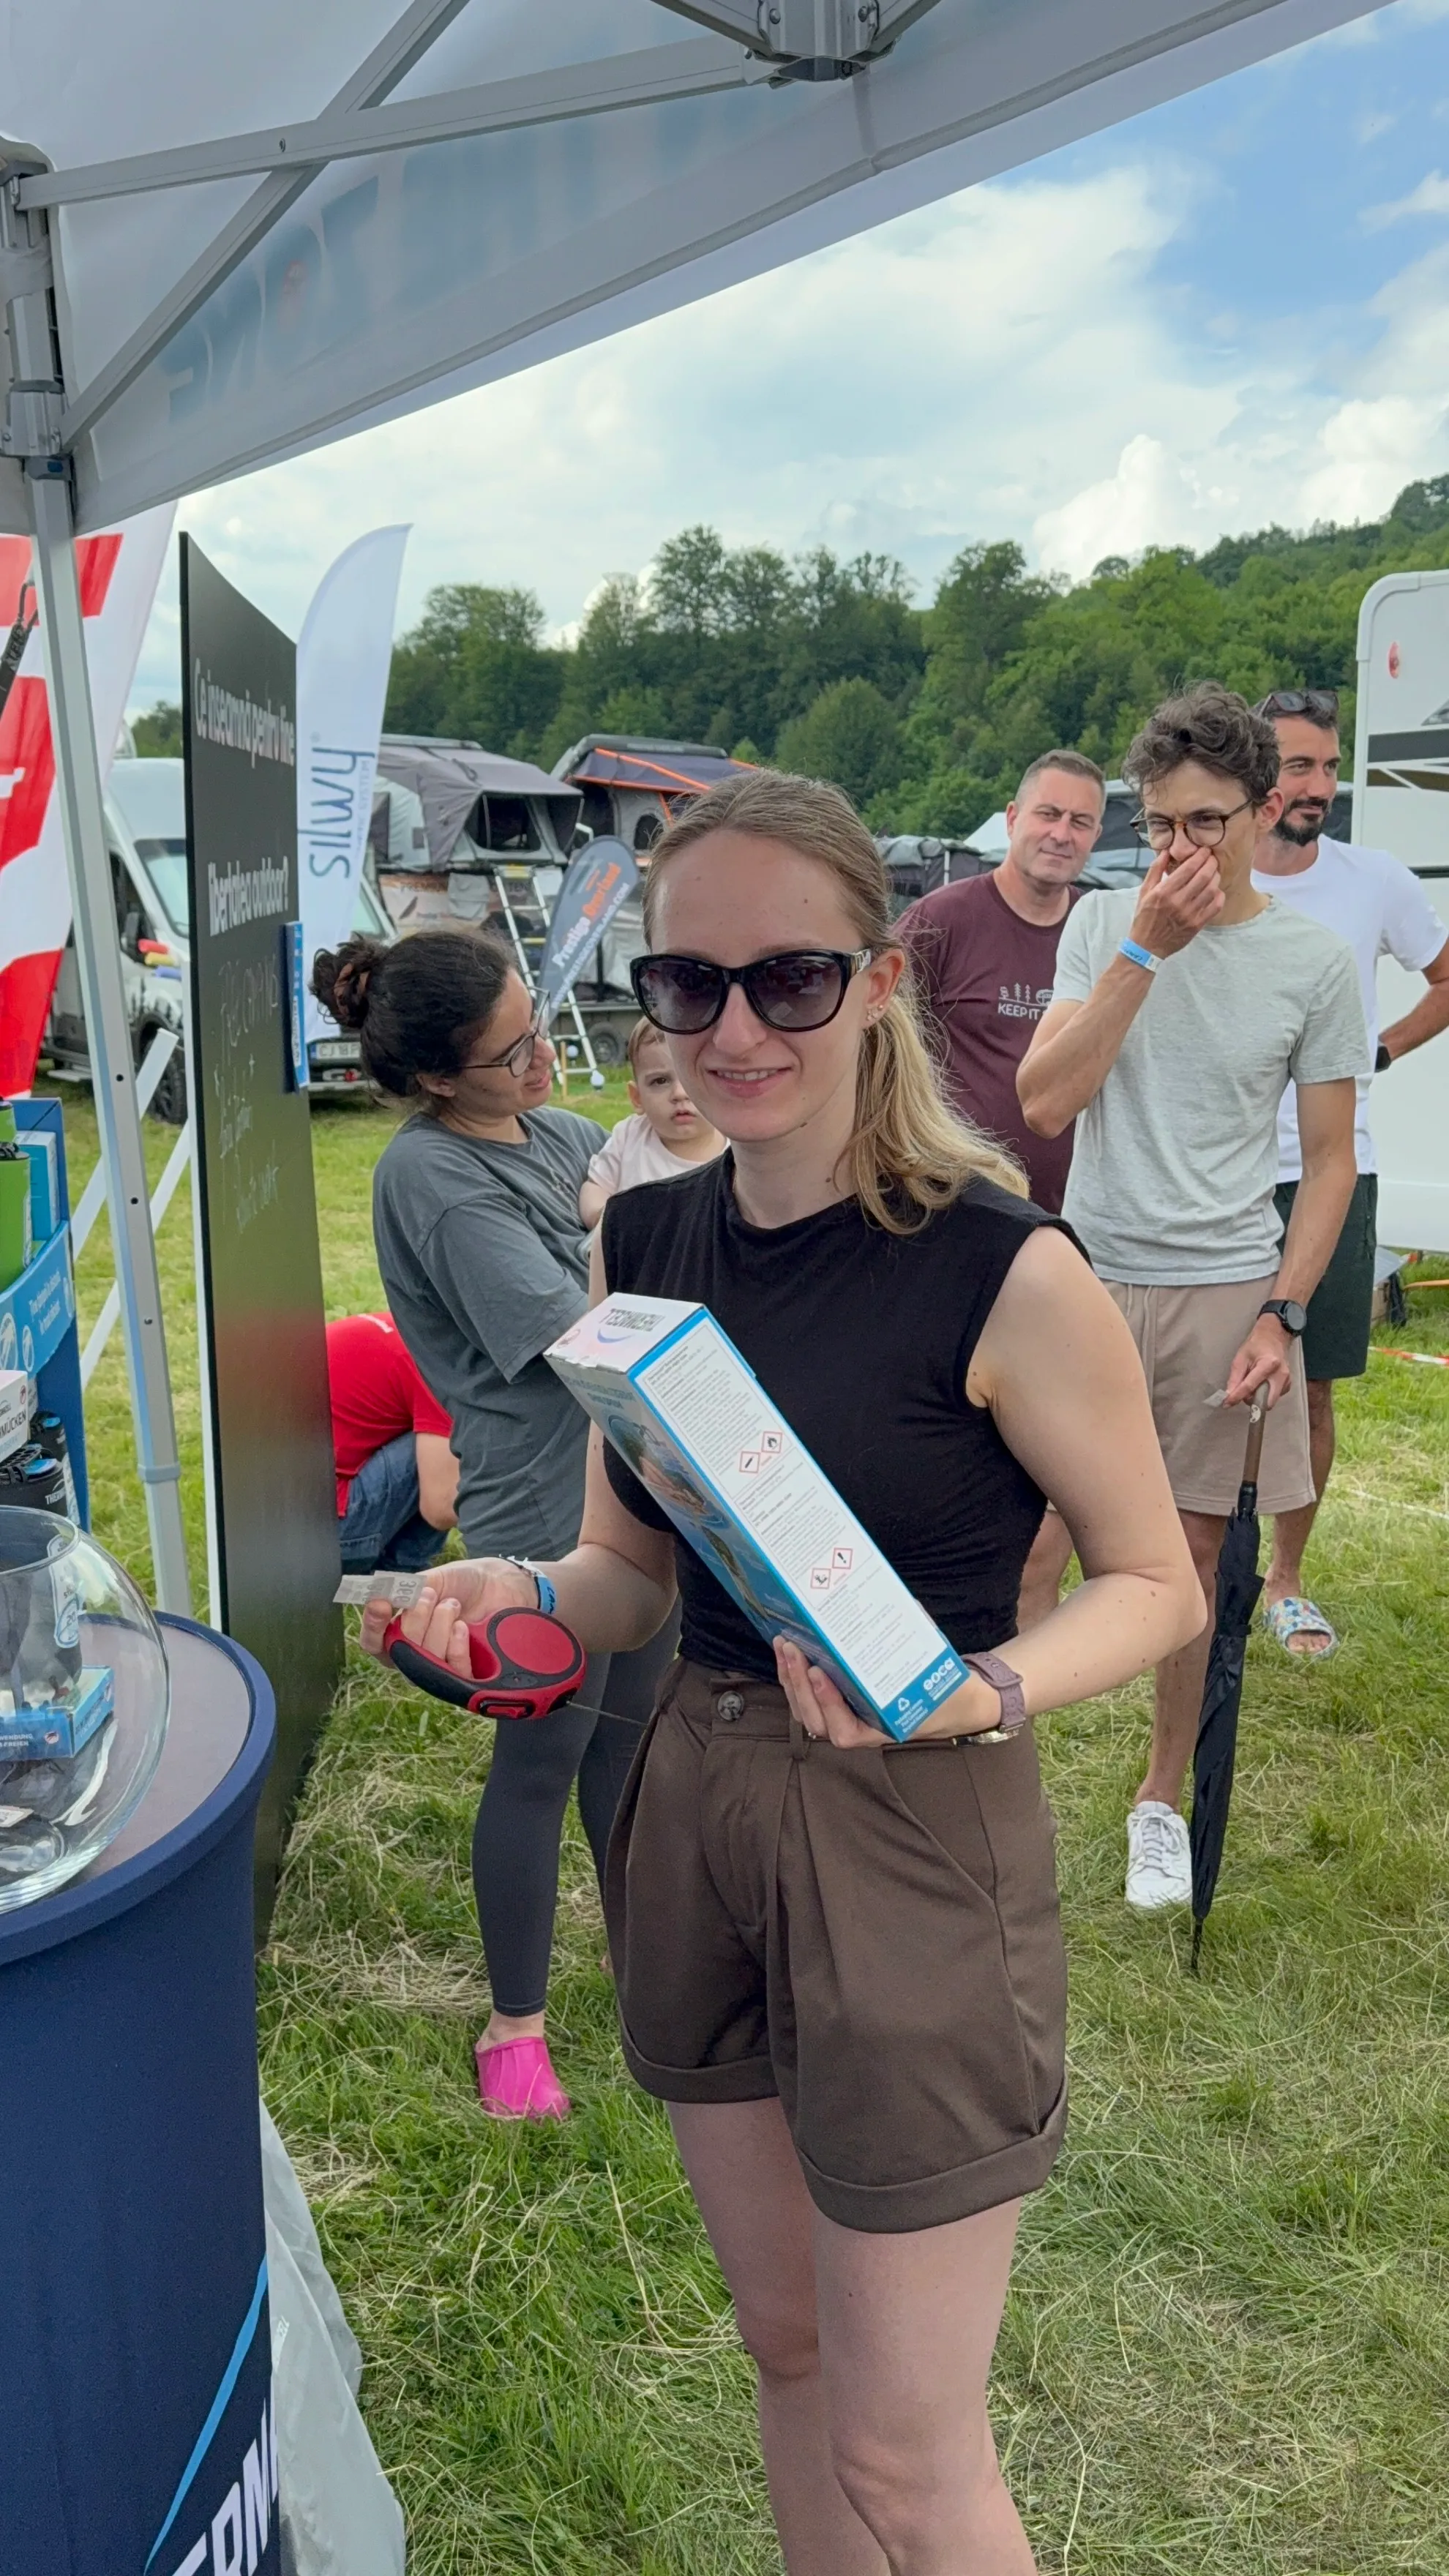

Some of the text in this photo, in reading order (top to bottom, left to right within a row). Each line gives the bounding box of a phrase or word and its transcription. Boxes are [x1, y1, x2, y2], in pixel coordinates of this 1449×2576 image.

[195, 657, 206, 738] Ce
[298, 746, 375, 879] silwy
[997, 1002, 1041, 1021] KEEP IT
[0, 1409, 26, 1439] MÜCKEN
